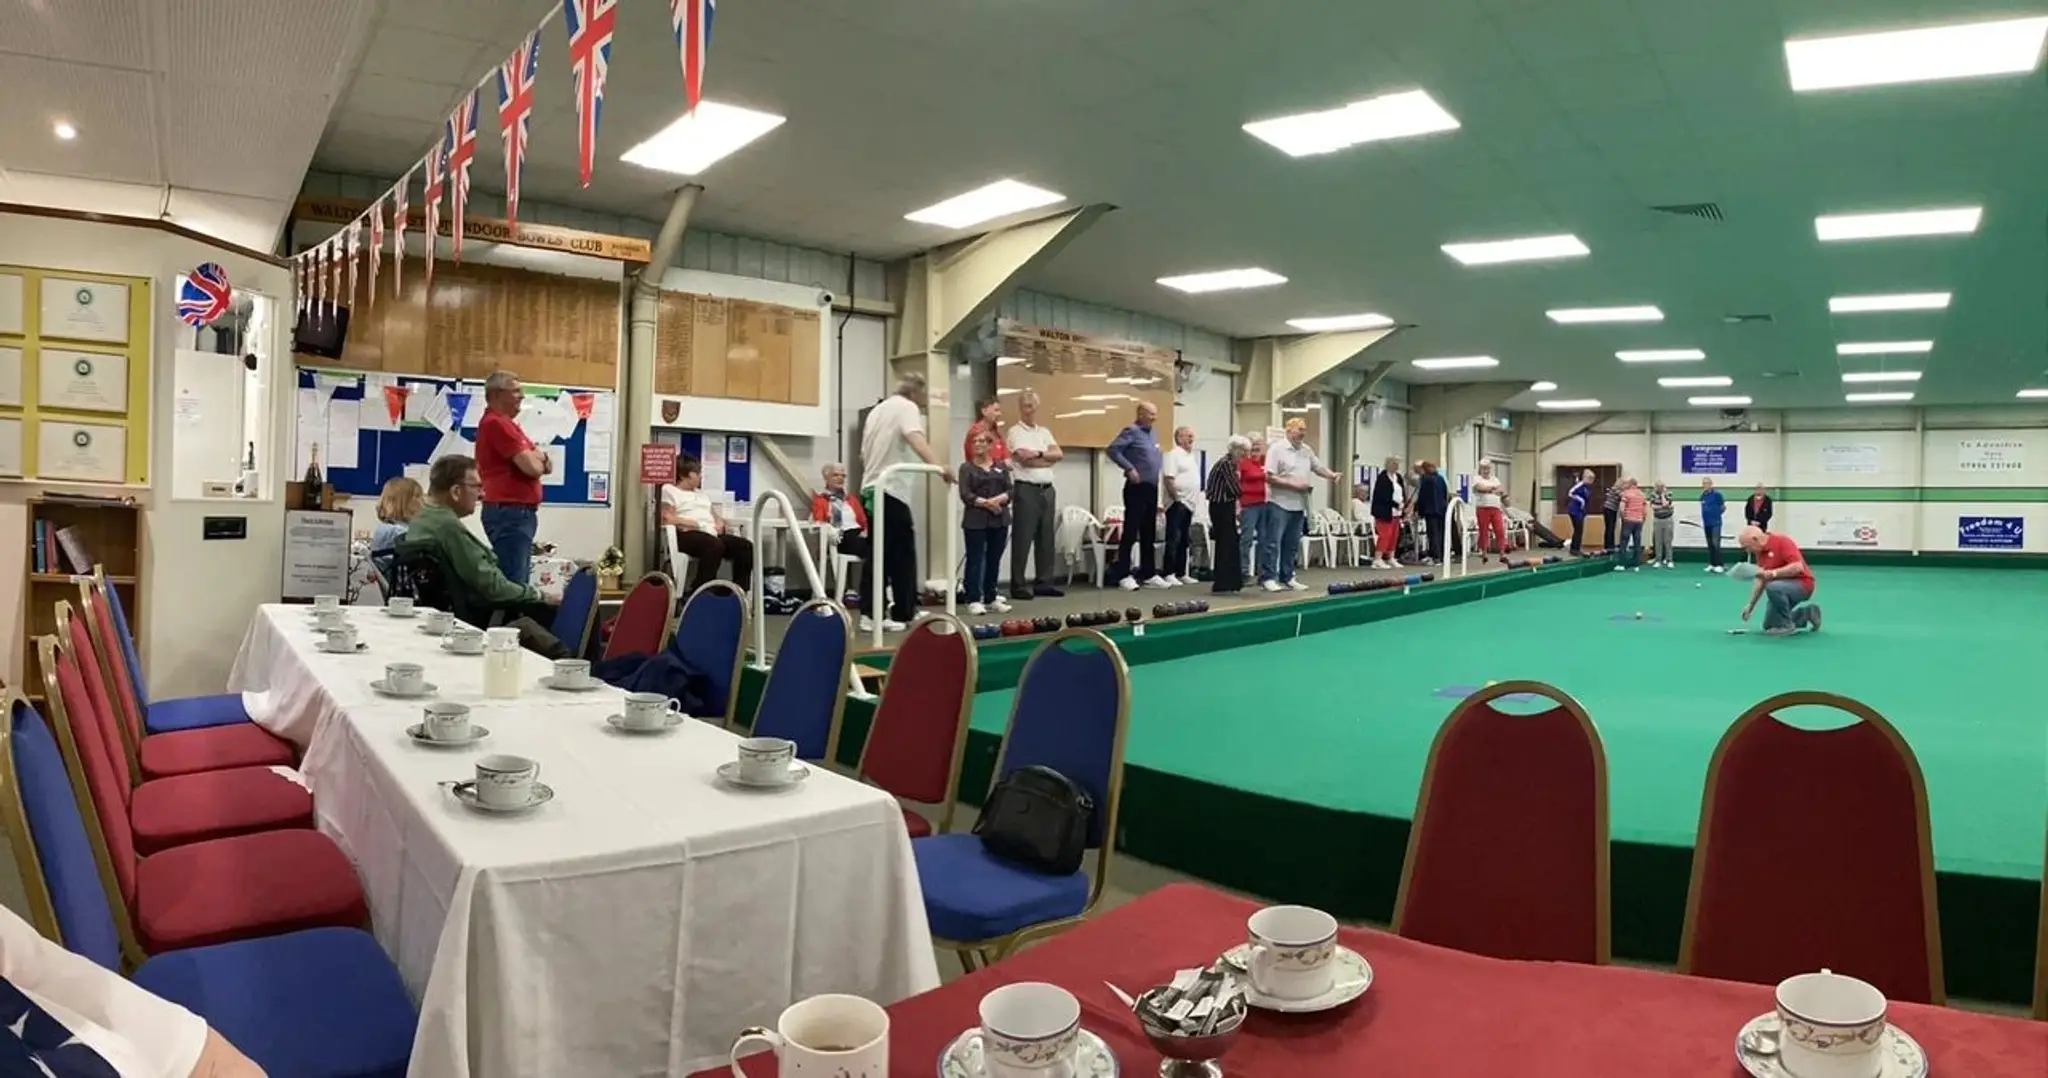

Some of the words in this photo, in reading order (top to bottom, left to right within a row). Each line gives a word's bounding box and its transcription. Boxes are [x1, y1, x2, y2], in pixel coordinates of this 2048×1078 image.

[463, 221, 511, 239] NDOOR
[570, 238, 603, 253] CLUB
[1039, 328, 1070, 341] WALTON
[1959, 518, 2003, 535] Freedom
[2006, 522, 2014, 530] 4
[2014, 526, 2023, 535] U
